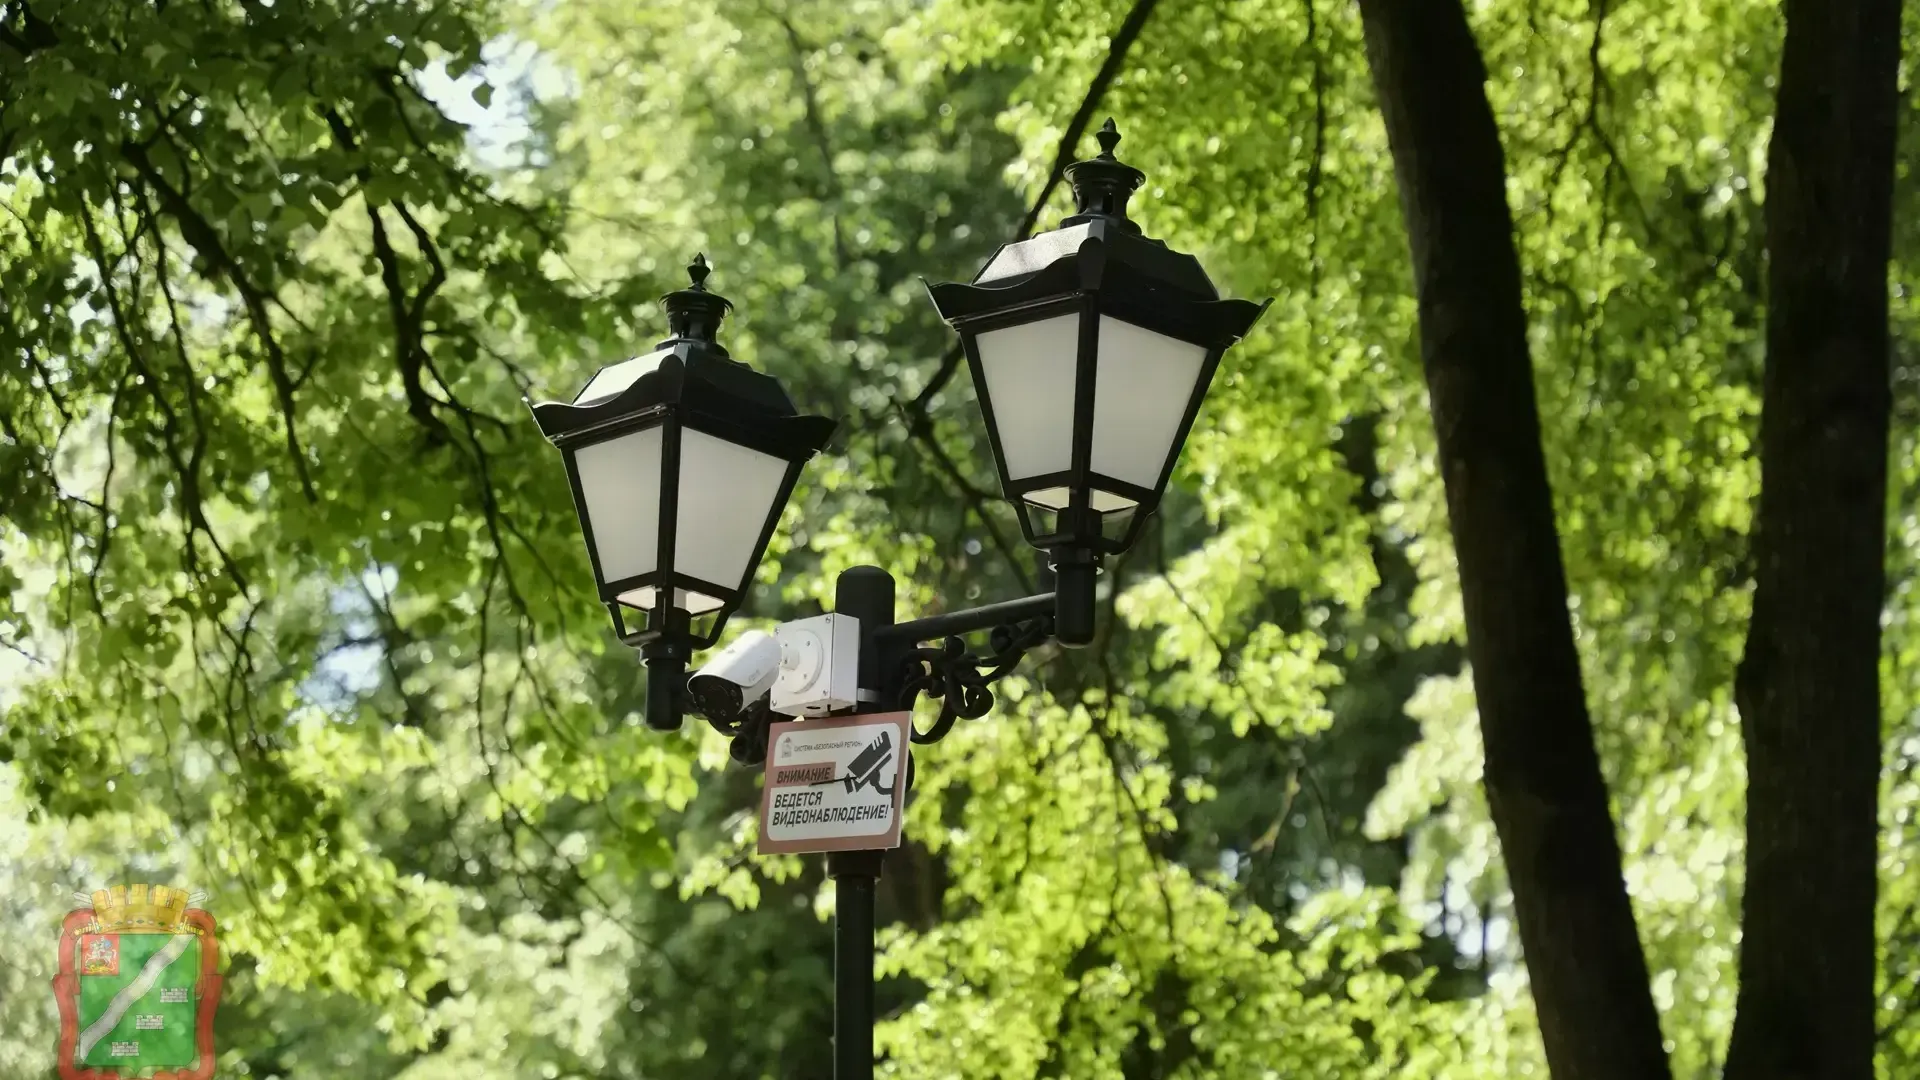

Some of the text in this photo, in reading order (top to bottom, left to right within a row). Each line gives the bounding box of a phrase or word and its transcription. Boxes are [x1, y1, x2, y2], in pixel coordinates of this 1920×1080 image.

[776, 767, 831, 784] ВНИМАНИЕ
[774, 791, 823, 810] ВЕДЕТСЯ
[772, 804, 889, 828] ВИДЕОНАБЛЮДЕНИЕ!
